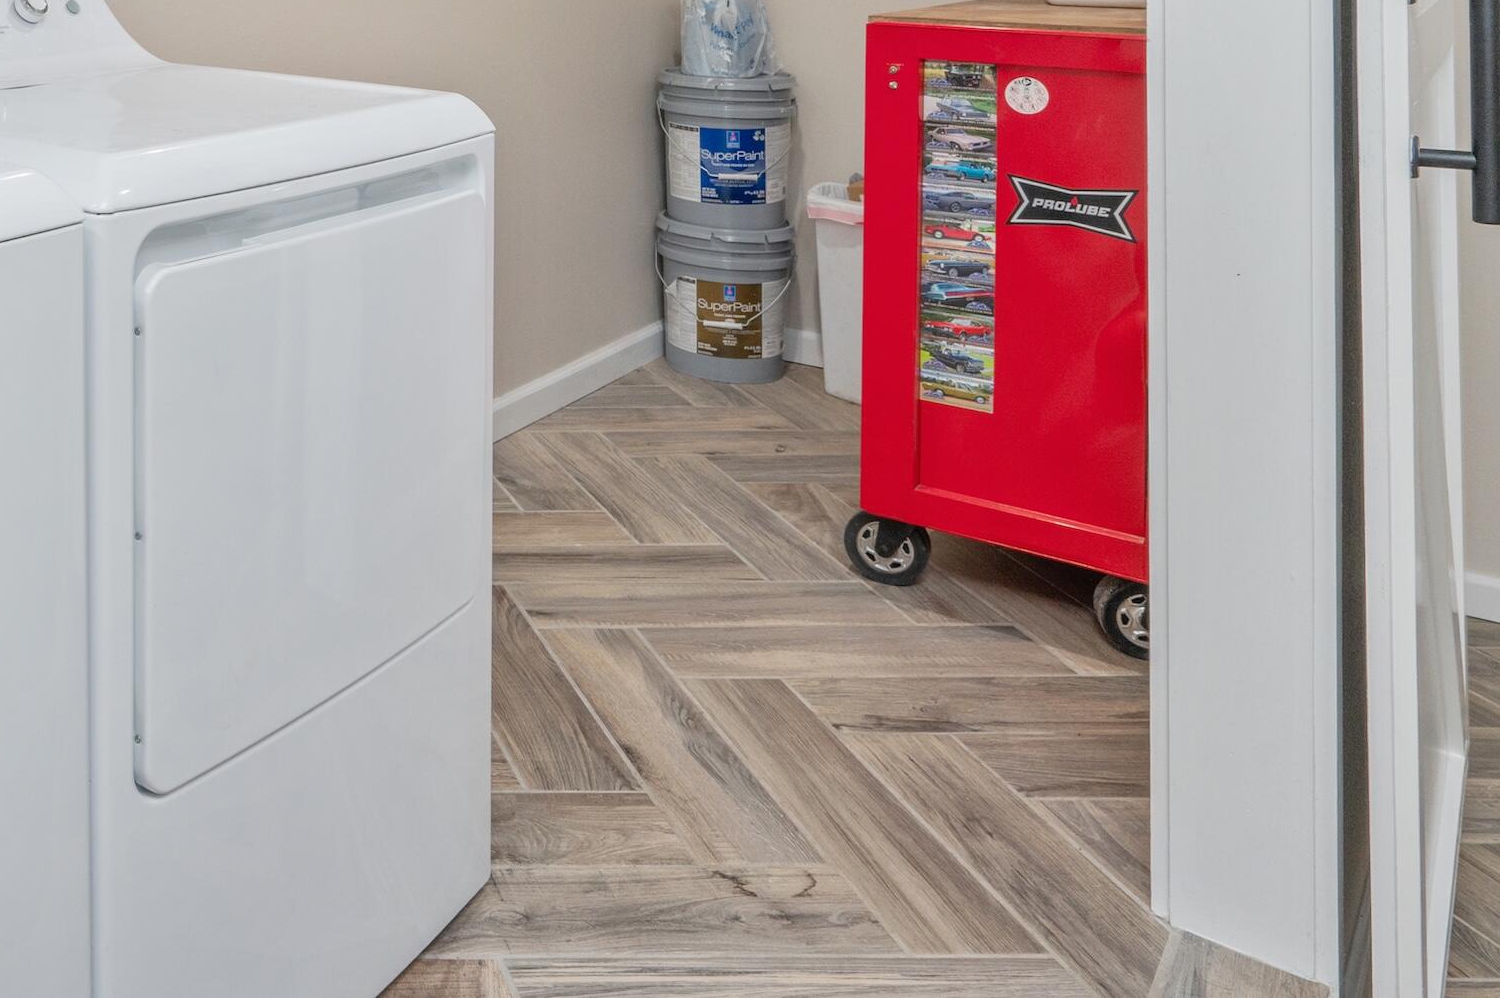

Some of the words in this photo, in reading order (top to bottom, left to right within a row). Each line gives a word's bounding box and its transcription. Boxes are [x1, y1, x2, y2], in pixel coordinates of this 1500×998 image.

[701, 148, 765, 162] SuperPaint
[1032, 197, 1112, 218] PROLUBE
[697, 297, 761, 313] SuperPaint
